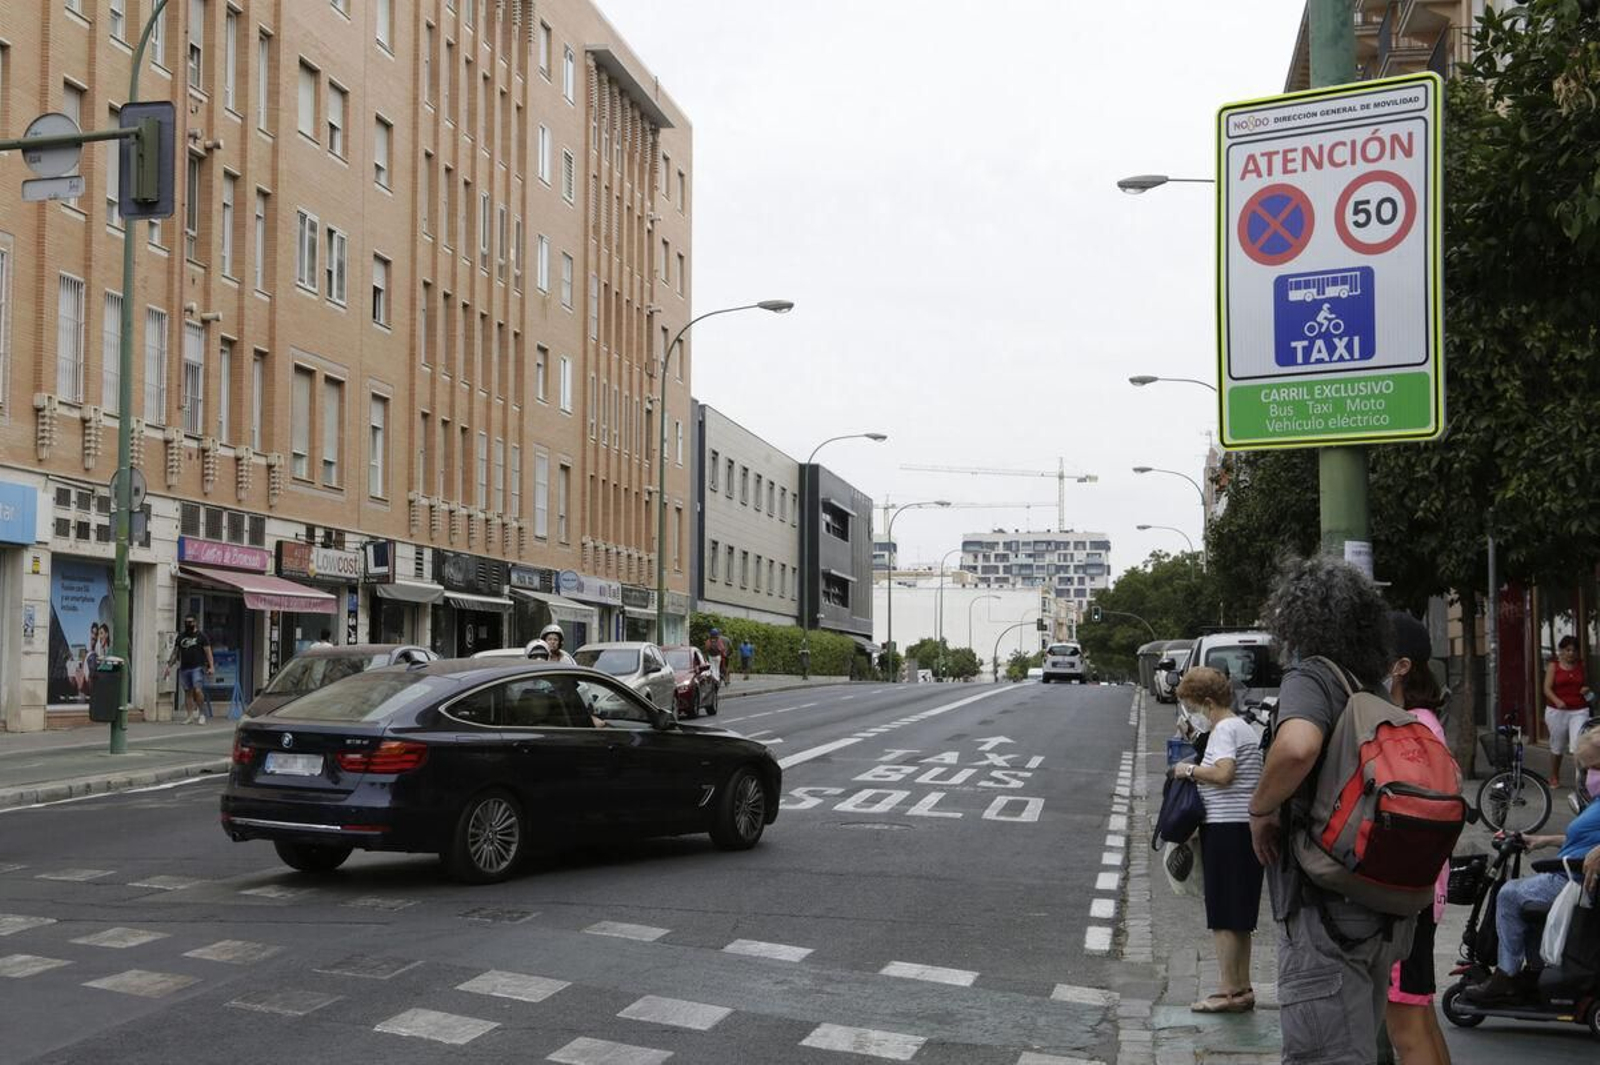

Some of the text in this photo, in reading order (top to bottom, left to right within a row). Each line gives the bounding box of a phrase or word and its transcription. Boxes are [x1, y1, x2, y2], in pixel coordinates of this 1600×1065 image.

[1273, 111, 1318, 125] DIRECCIÓN
[1320, 105, 1358, 118] GENERAL
[1360, 103, 1371, 111] DE
[1373, 95, 1420, 109] MOVILIDAD
[1239, 128, 1414, 181] ATENCIÓN
[1352, 196, 1398, 229] 50
[1290, 336, 1361, 364] TAXI
[1260, 379, 1394, 403] CARRIL EXCLUSIVO
[1269, 397, 1386, 418] Bus Taxi Moto
[1266, 412, 1390, 433] Vehículo eléctrico
[874, 748, 1046, 769] TAXI
[851, 764, 1034, 789] BUS
[779, 786, 1046, 822] SOLO
